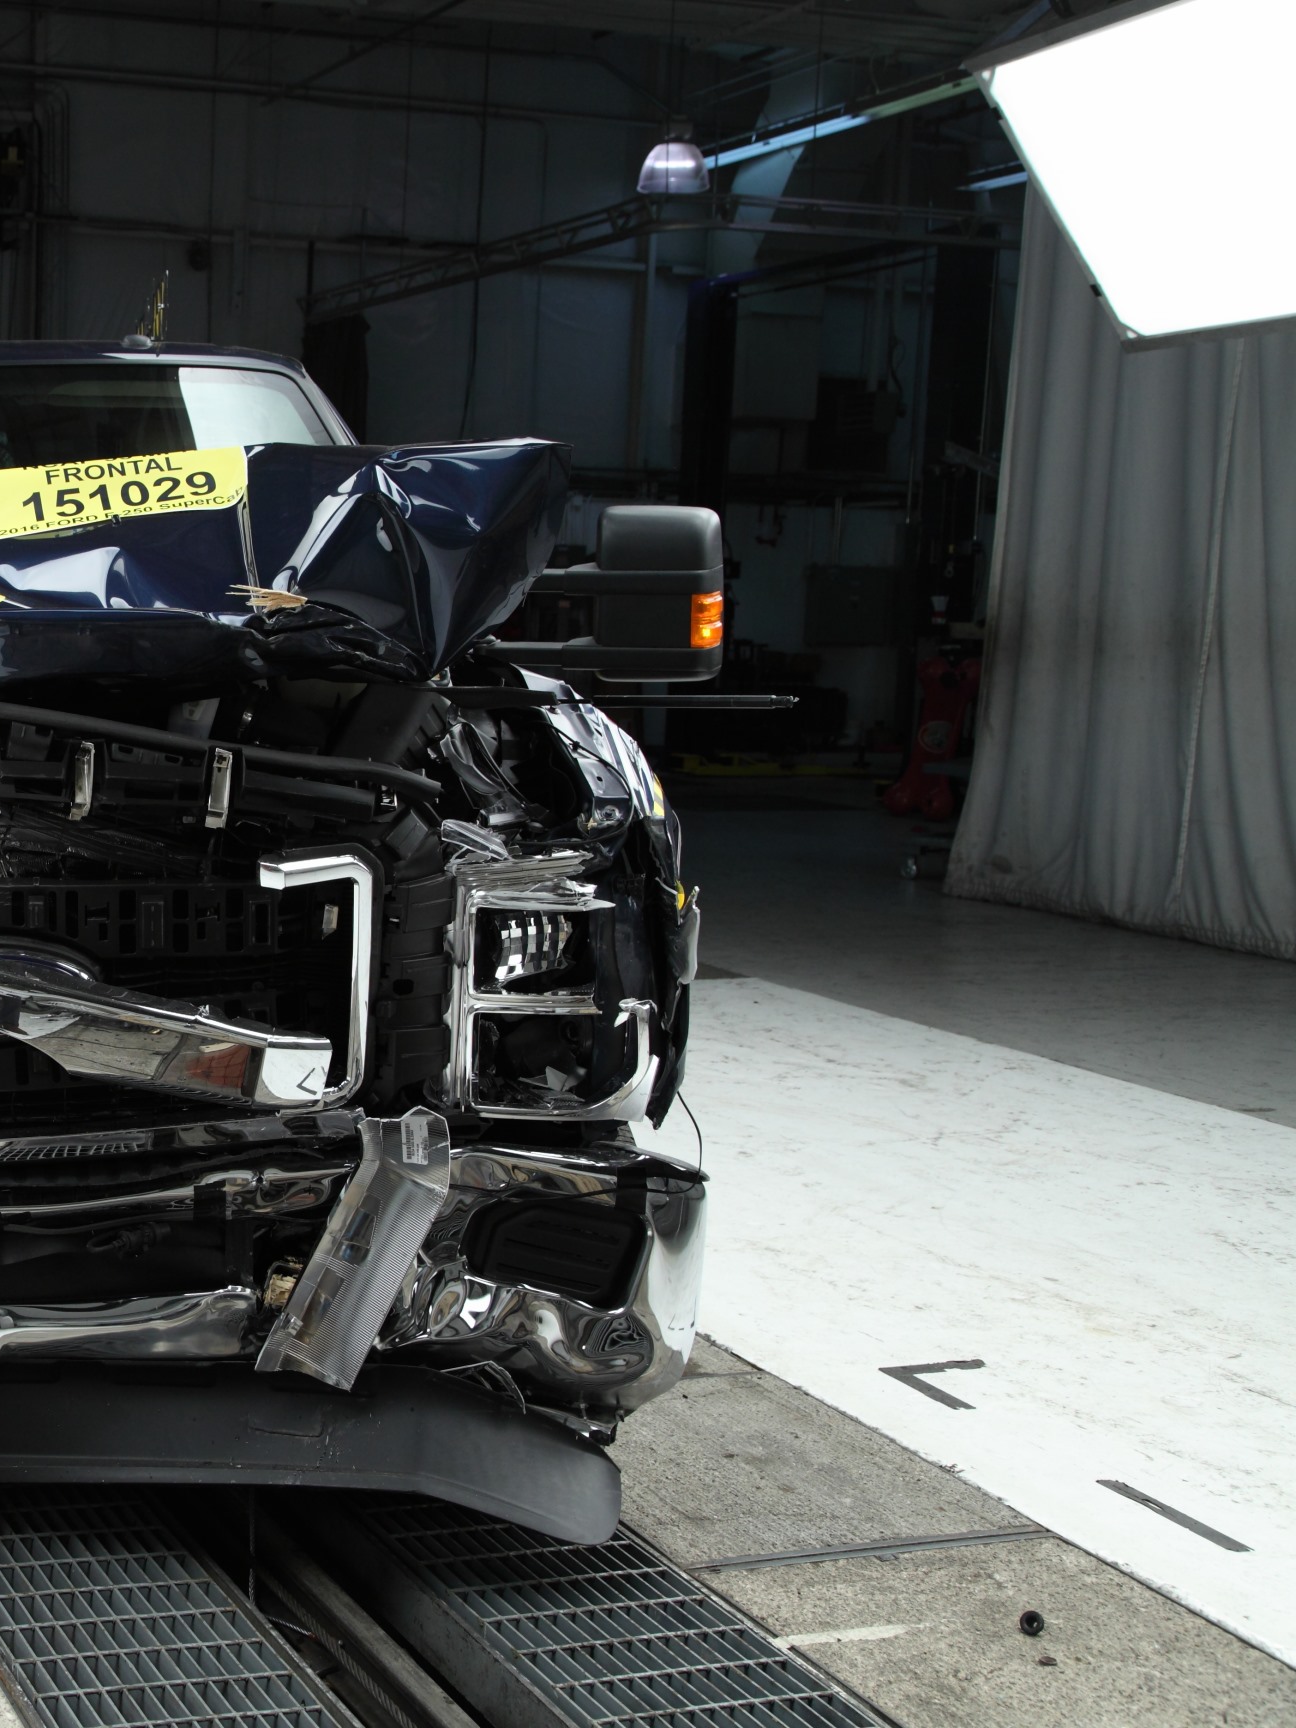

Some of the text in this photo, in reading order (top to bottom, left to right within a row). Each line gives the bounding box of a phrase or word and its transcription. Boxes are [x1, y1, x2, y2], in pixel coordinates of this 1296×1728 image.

[45, 456, 183, 485] FRONTAL
[22, 471, 217, 522] 151029
[45, 514, 99, 529] FORD
[159, 487, 243, 510] SuperCab
